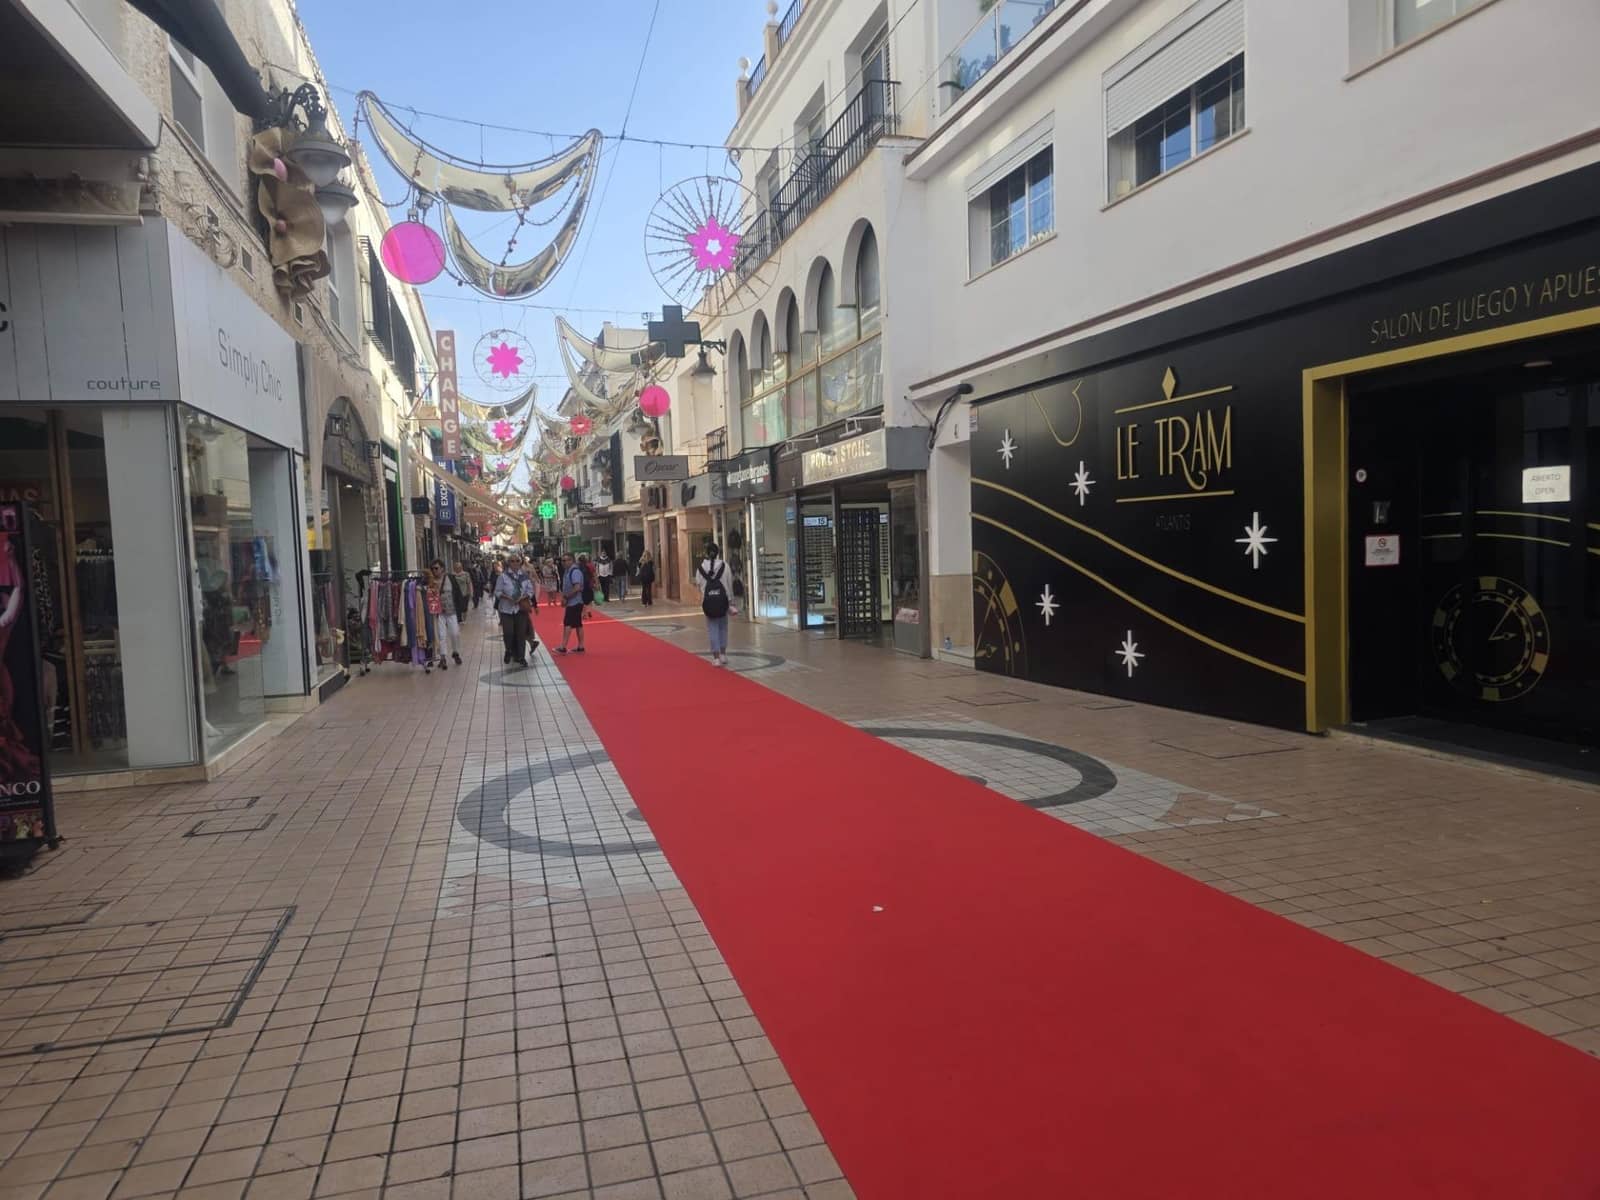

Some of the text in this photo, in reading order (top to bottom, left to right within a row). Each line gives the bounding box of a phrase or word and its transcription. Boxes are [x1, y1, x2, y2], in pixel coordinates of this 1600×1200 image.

[1371, 312, 1424, 344] SALON
[1429, 302, 1451, 331] DE
[1454, 286, 1518, 330] JUEGO
[1523, 282, 1536, 308] Y
[87, 377, 161, 390] couture
[217, 327, 283, 401] Simply Chic
[440, 336, 457, 454] CHANGE
[1116, 405, 1232, 490] LE TRAM
